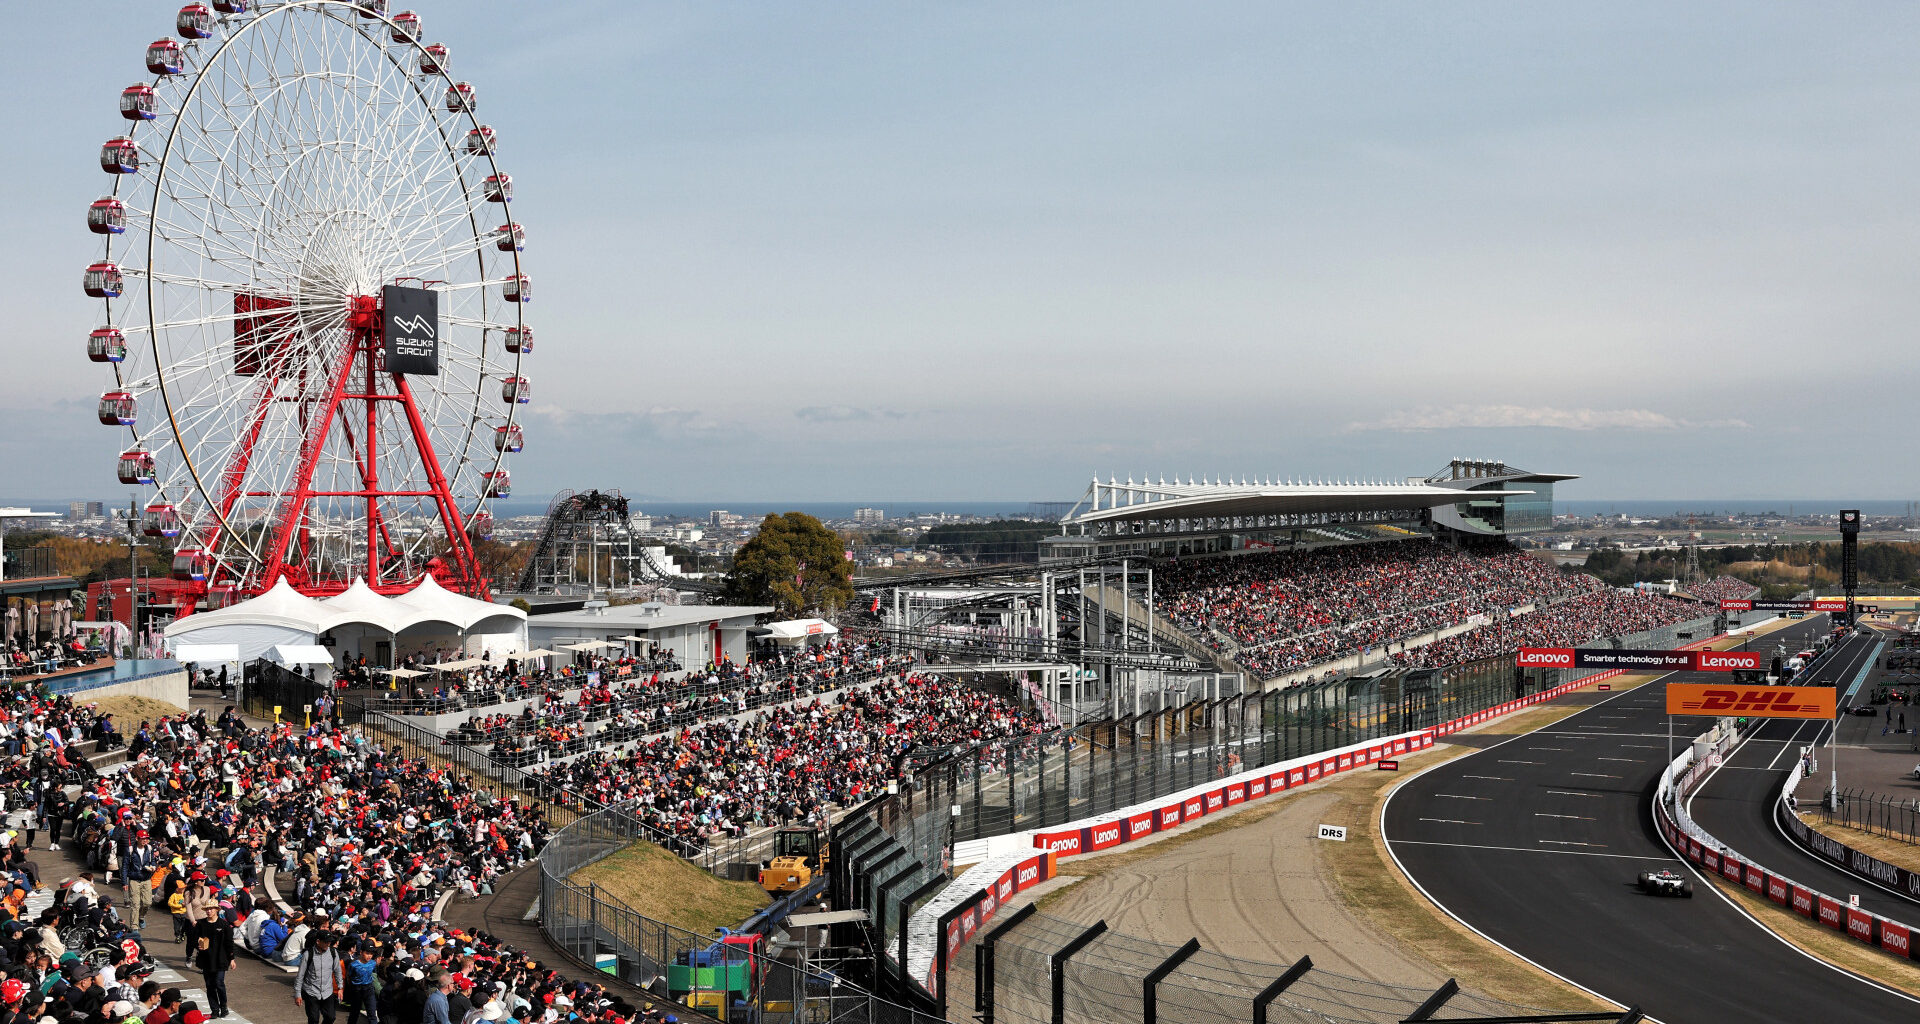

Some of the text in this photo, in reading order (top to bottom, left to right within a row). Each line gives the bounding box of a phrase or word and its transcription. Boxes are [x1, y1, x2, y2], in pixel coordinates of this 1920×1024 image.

[396, 338, 434, 348] SUZUKA
[397, 347, 432, 356] CIRCUIT
[1520, 652, 1570, 663] Lenovo
[1584, 654, 1688, 665] Smarter technology for all
[1702, 655, 1755, 667] Lenovo
[1700, 690, 1801, 712] DHL
[1271, 777, 1284, 788] Lenovo
[1208, 795, 1222, 808] Lenovo
[1228, 788, 1243, 800] Lenovo
[1163, 810, 1179, 824] Lenovo
[1186, 802, 1200, 816] Lenovo
[1131, 818, 1150, 834] Lenovo
[1322, 828, 1342, 837] DRS
[1094, 828, 1118, 844] Lenovo
[1042, 838, 1078, 851] Lenovo
[1018, 865, 1037, 884] Lenovo
[1724, 861, 1739, 877] Lenovo
[1852, 850, 1897, 885] QATAR AIRWAYS
[1747, 870, 1762, 888] Lenovo
[1000, 878, 1012, 898] Lenovo
[1770, 881, 1785, 899] Lenovo
[1793, 891, 1810, 911] Lenovo
[1820, 903, 1838, 922] Lenovo
[1848, 914, 1870, 935] Lenovo
[1883, 927, 1906, 950] Lenovo
